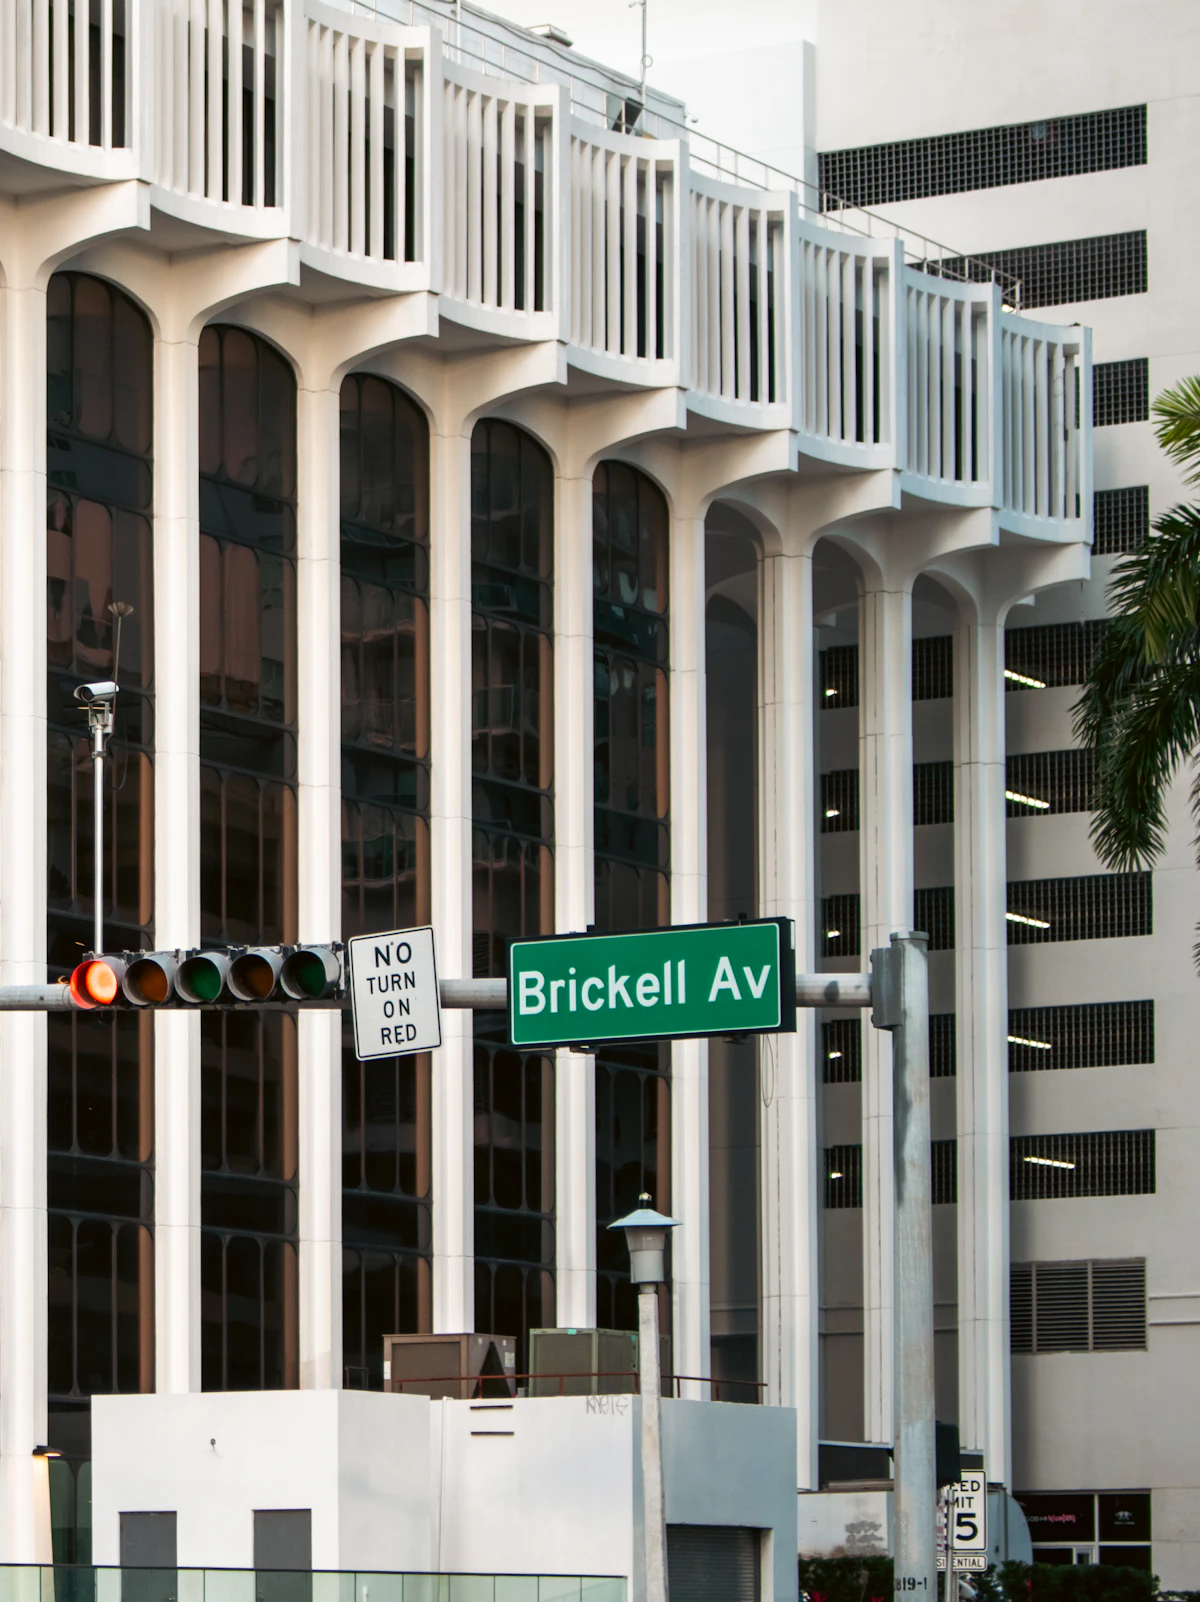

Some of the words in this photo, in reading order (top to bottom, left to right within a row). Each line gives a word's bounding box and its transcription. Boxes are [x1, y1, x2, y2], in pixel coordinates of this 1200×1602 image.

[374, 942, 412, 968] NO
[366, 971, 416, 995] TURN
[518, 959, 686, 1015] Brickell
[708, 956, 771, 1002] Av
[383, 998, 410, 1018] ON
[381, 1023, 417, 1045] RED
[955, 1512, 979, 1542] 5
